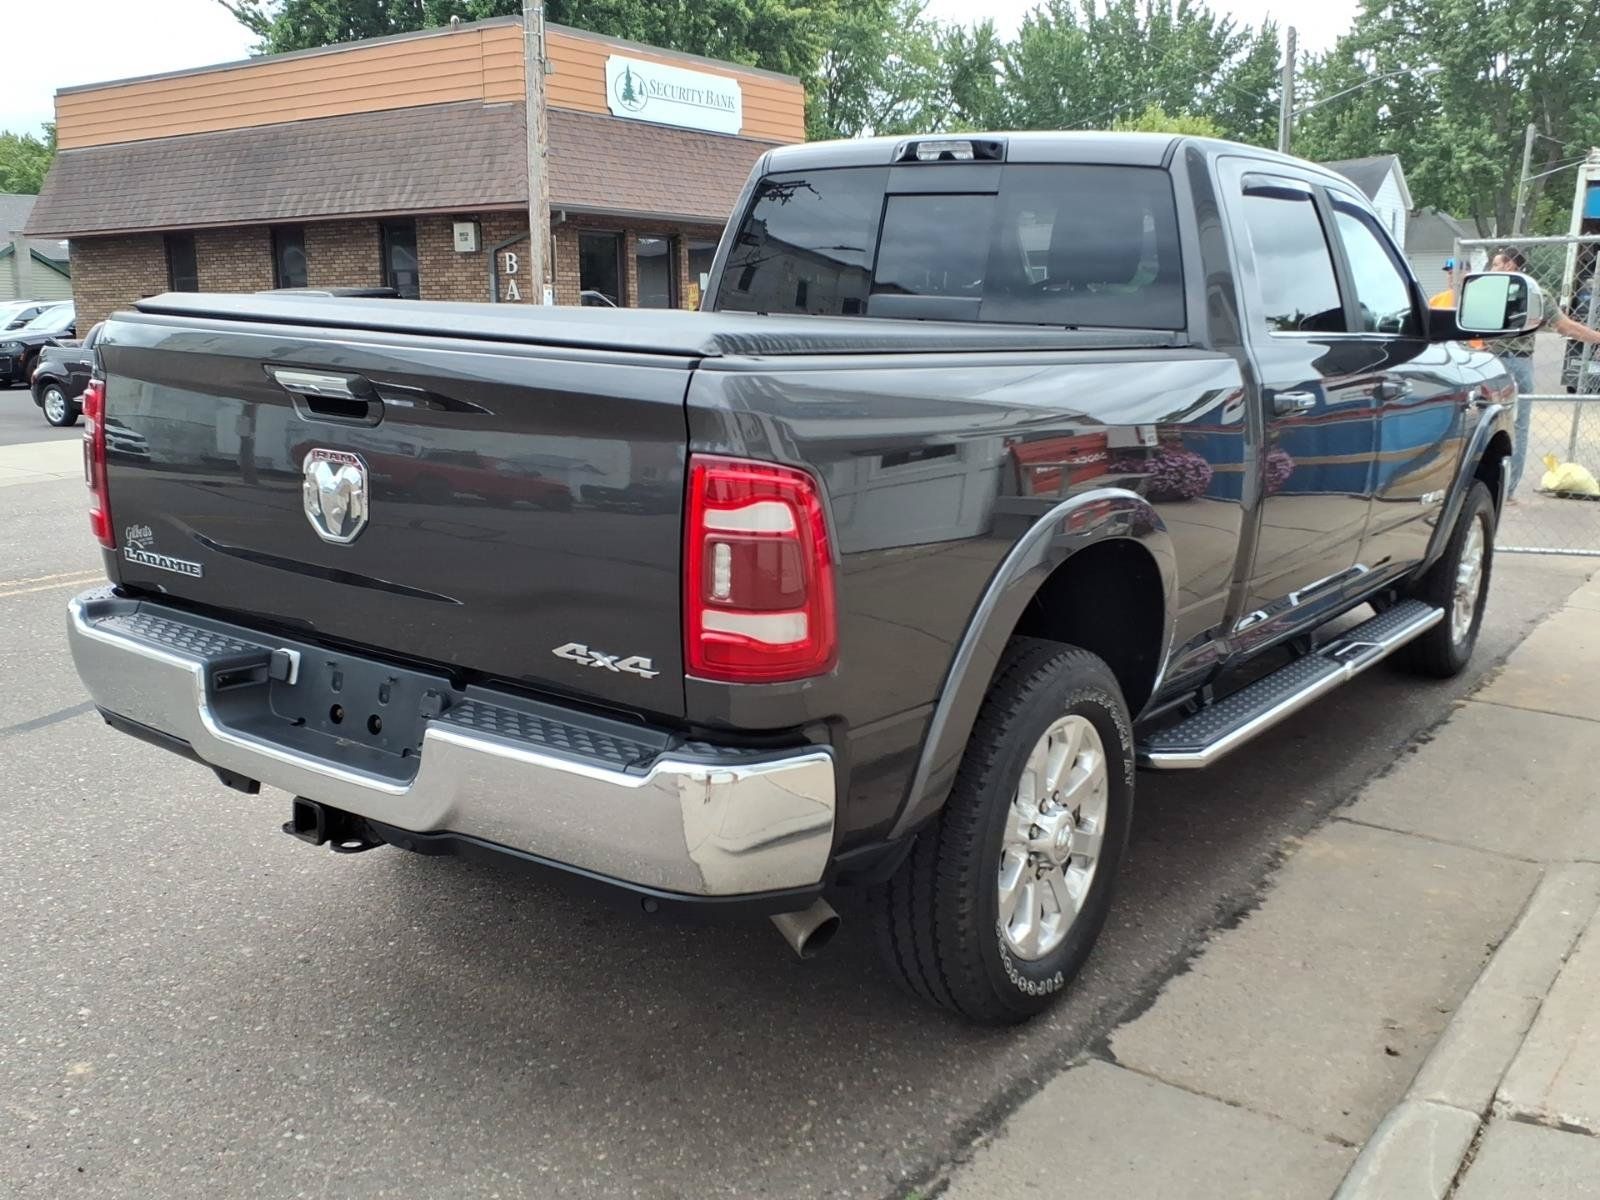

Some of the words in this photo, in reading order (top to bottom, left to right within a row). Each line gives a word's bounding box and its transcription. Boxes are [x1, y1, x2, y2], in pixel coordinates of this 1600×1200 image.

[649, 79, 704, 104] SECURITY
[706, 89, 735, 109] BANK
[314, 449, 354, 465] RAM
[124, 547, 203, 578] LARAMIE
